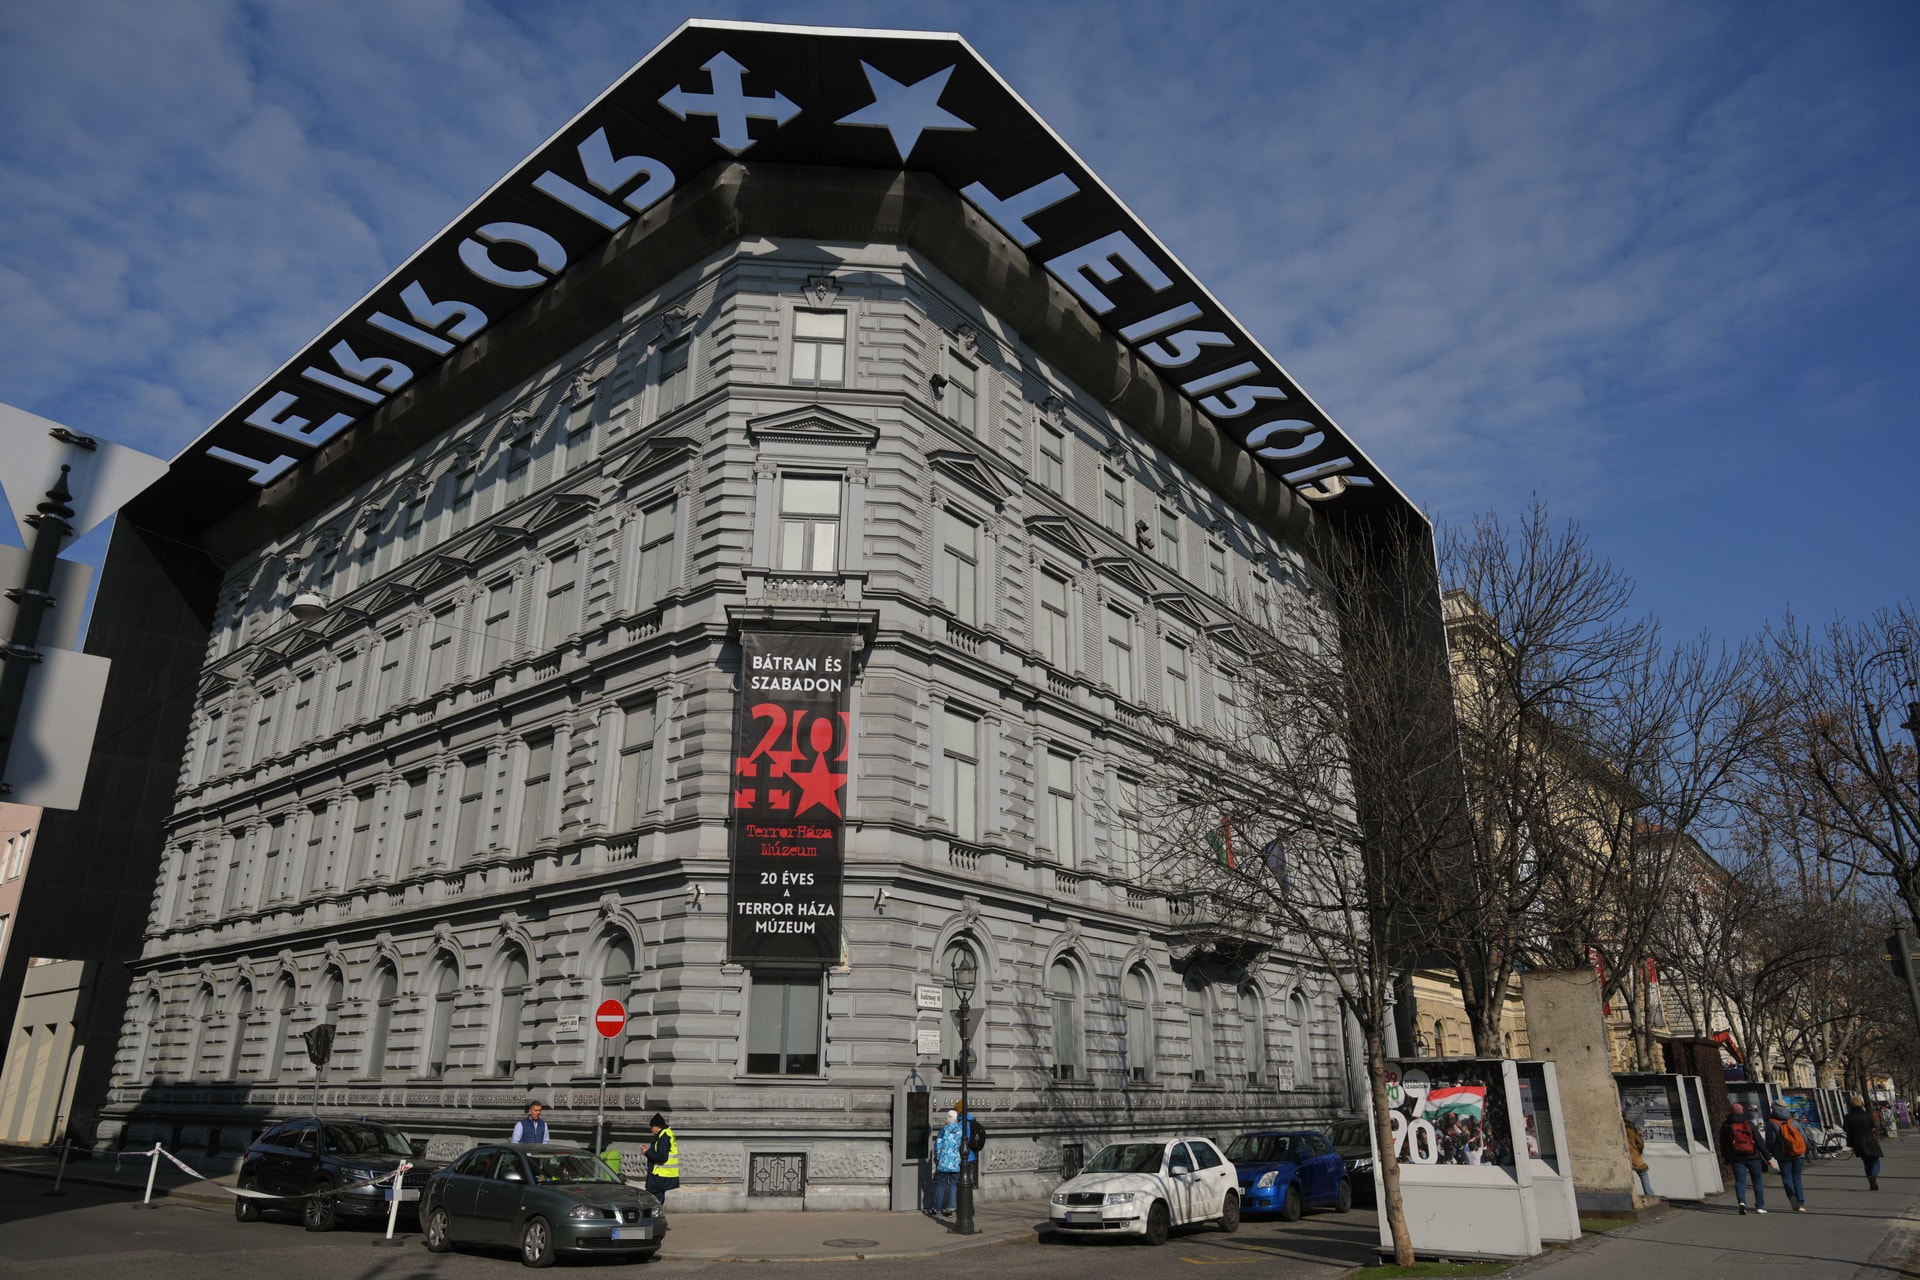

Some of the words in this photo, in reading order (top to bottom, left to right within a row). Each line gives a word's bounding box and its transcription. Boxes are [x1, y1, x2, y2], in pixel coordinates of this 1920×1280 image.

[752, 654, 817, 672] BÁTRAN
[824, 656, 842, 672] ÉS
[751, 676, 842, 692] SZABADON
[761, 841, 817, 857] Múzeum
[760, 873, 777, 885] 20
[782, 871, 814, 886] ÉVES
[784, 889, 790, 898] A
[737, 902, 793, 916] TERROR
[798, 901, 835, 917] HÁZA
[756, 918, 815, 934] MÚZEUM
